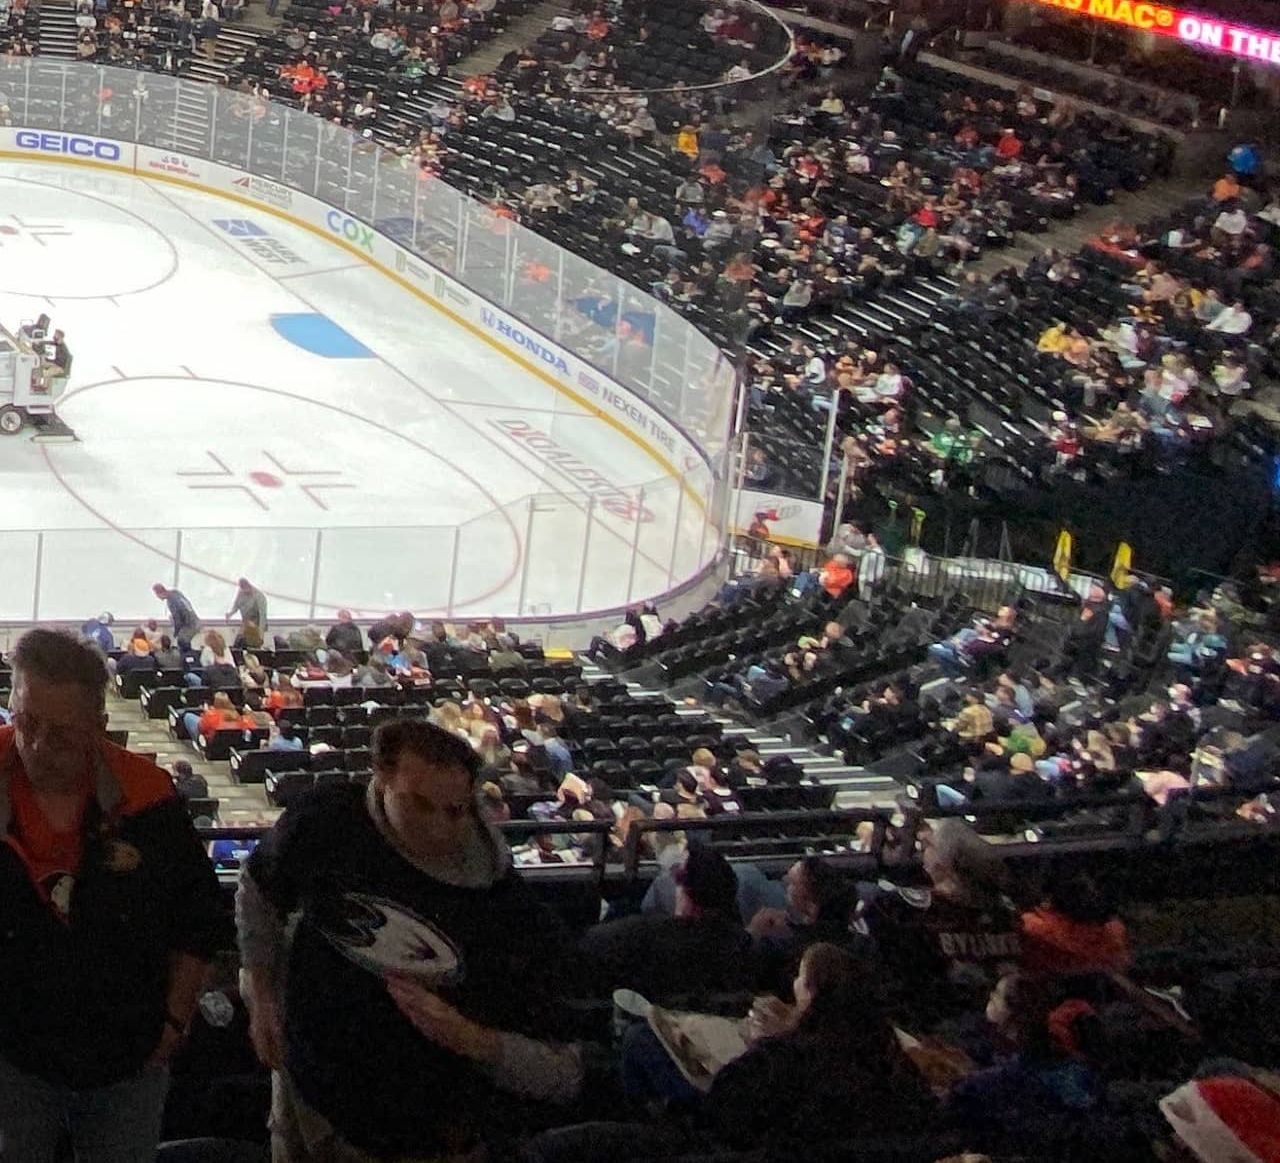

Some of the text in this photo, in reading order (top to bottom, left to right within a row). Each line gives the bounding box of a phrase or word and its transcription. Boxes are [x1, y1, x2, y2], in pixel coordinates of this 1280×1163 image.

[1179, 18, 1221, 46] ON
[16, 131, 120, 161] GEICO
[326, 211, 375, 252] COX
[496, 320, 570, 376] HONDA
[602, 388, 675, 454] NEXEN TIRE
